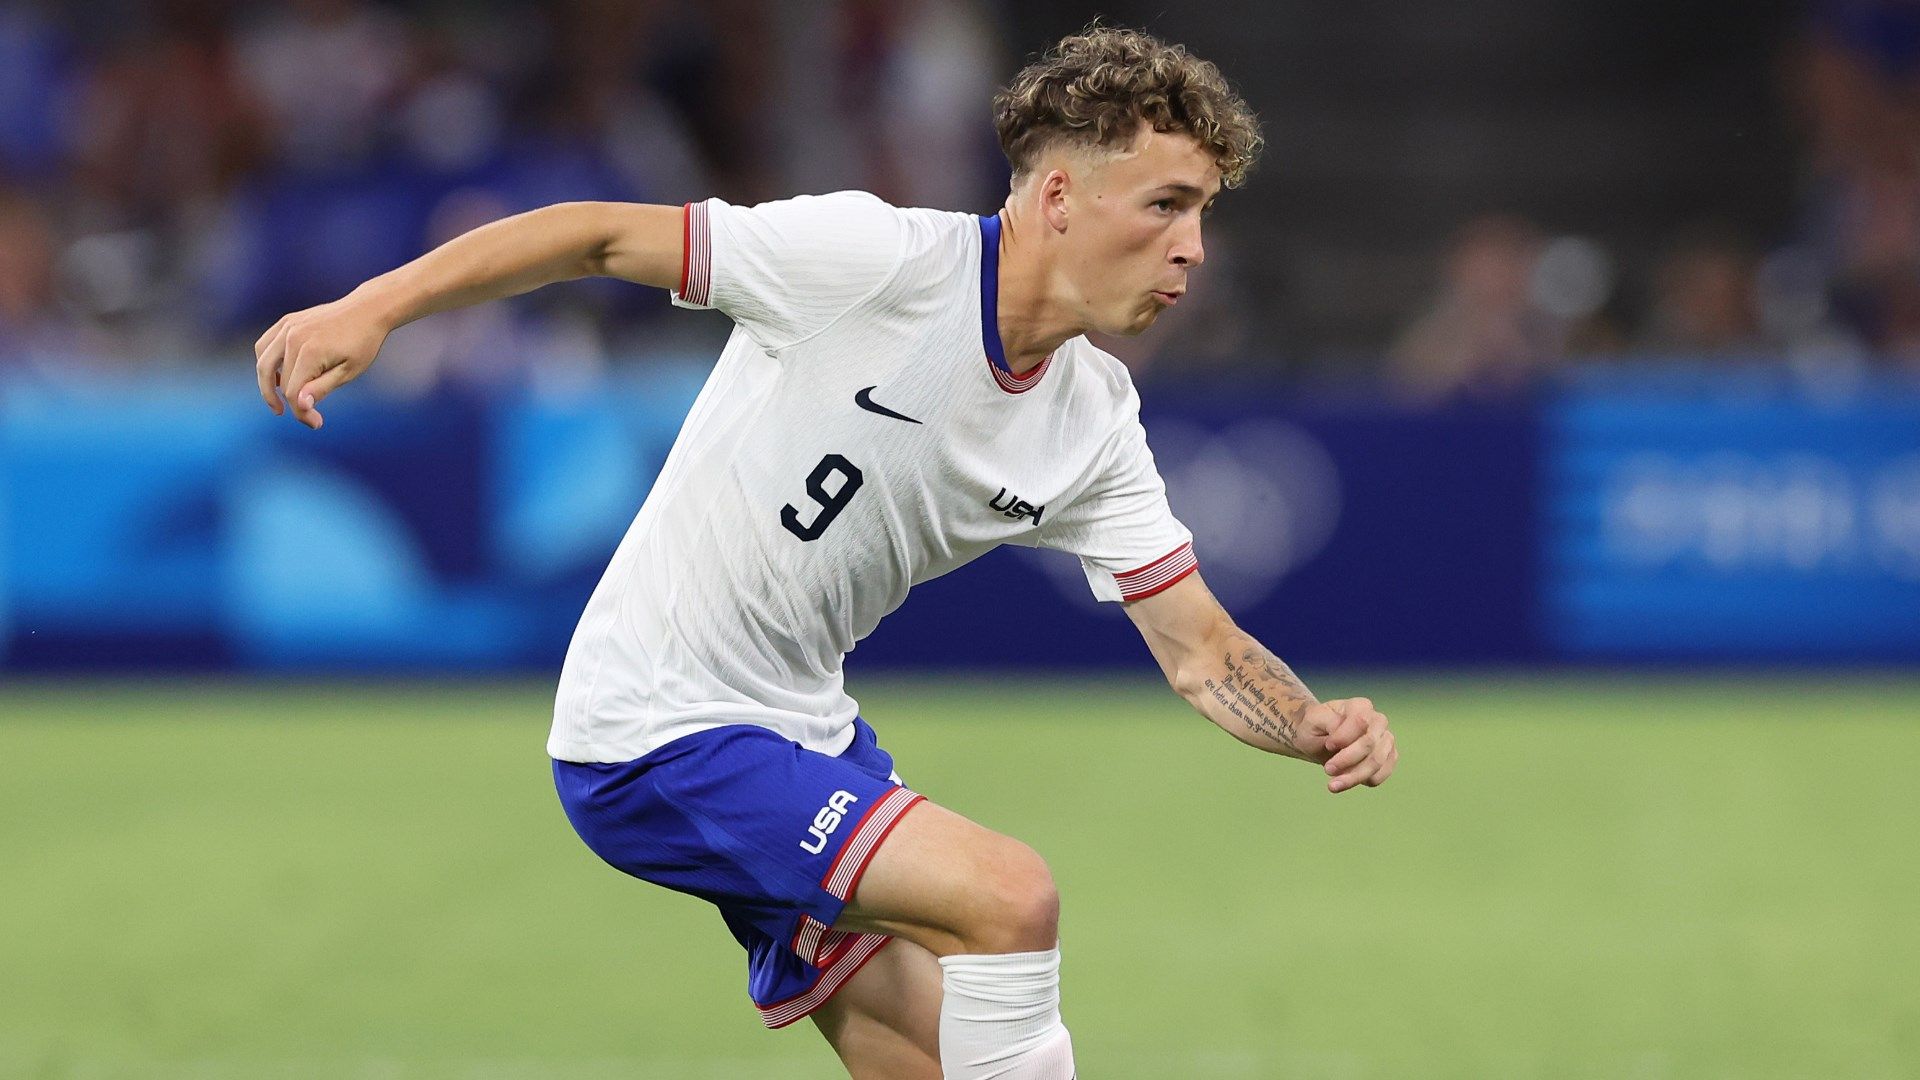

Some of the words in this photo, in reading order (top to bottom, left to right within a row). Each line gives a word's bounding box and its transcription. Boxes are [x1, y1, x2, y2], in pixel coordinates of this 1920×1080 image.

[780, 454, 864, 542] 9
[989, 487, 1045, 527] USA
[800, 790, 859, 855] USA
